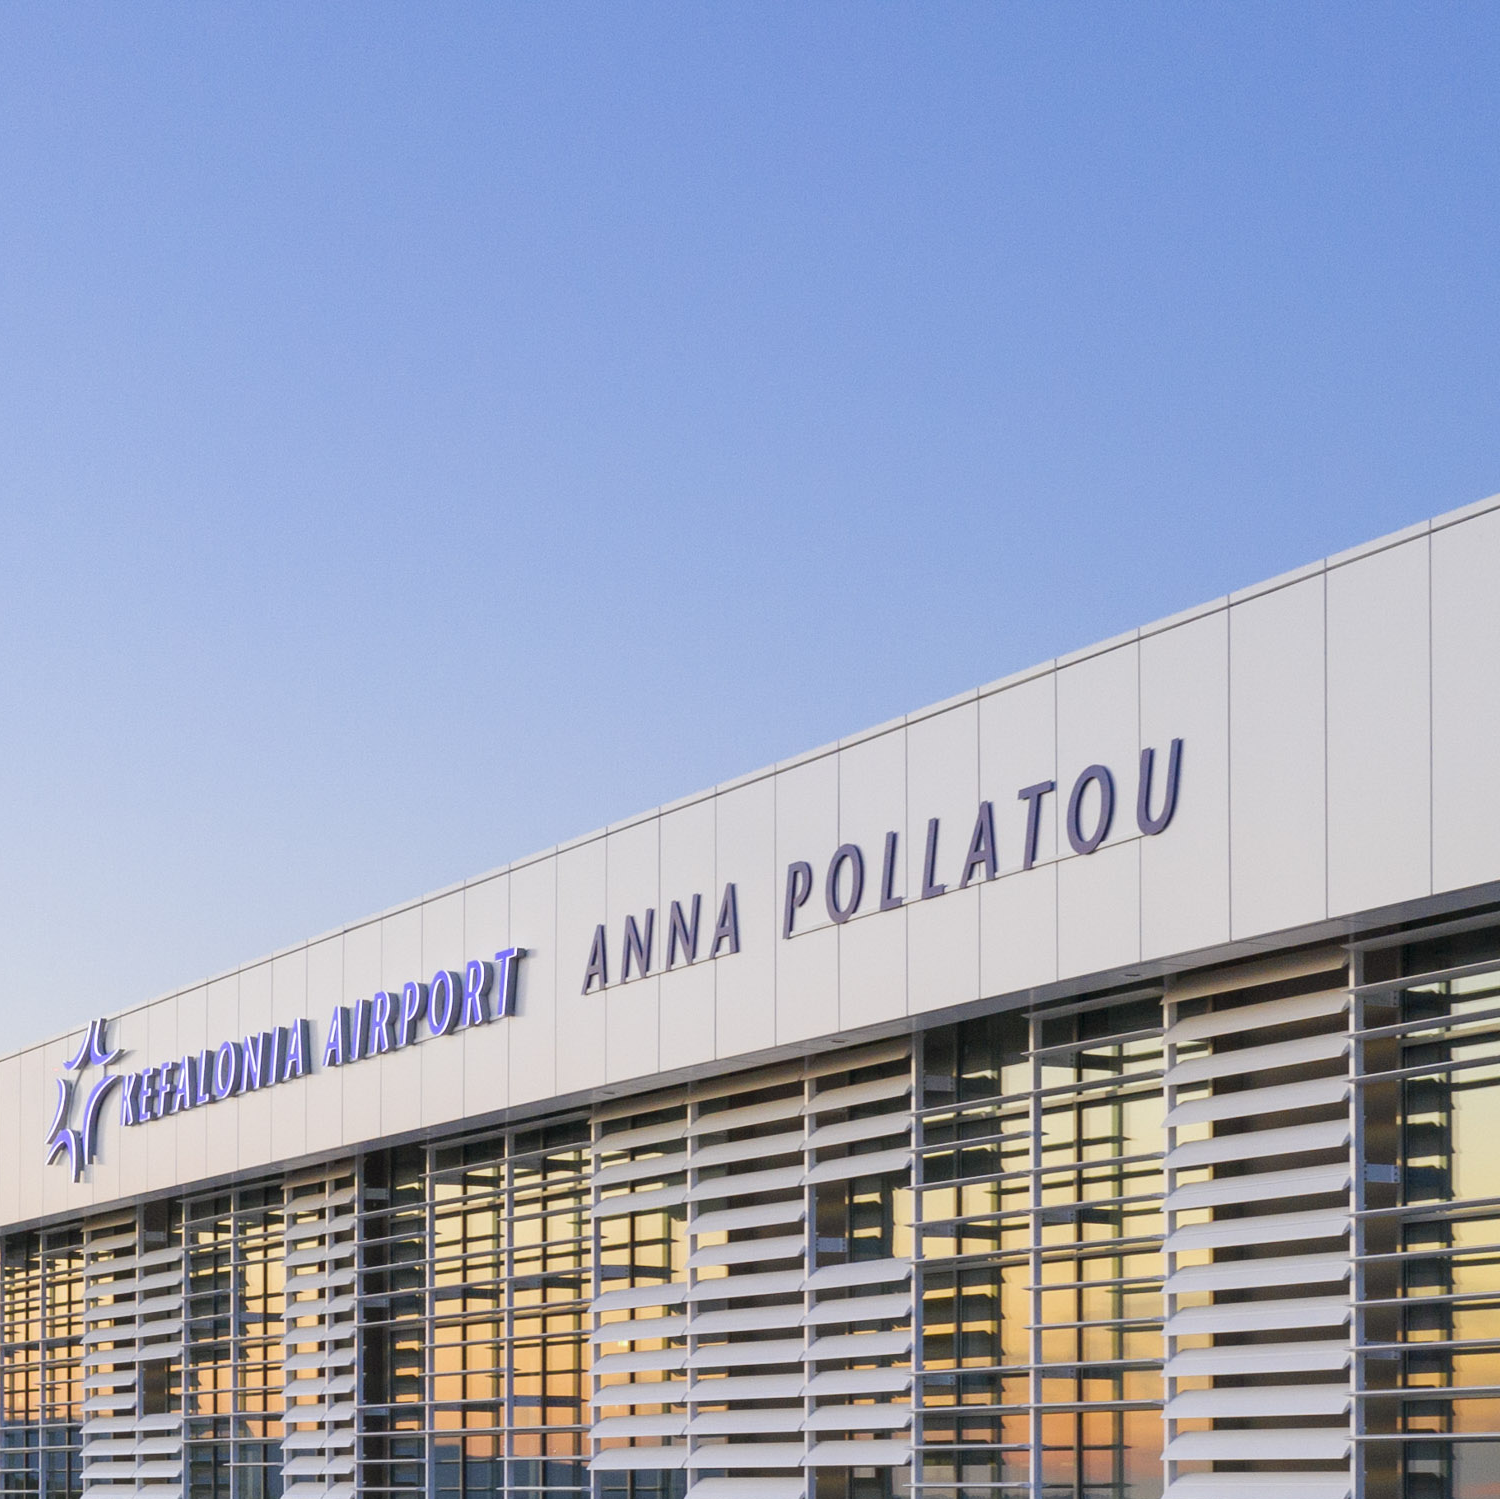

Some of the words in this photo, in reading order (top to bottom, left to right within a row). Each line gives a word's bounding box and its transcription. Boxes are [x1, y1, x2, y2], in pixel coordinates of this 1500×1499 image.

[581, 882, 740, 996] ANNA
[782, 738, 1184, 939] POLLATOU
[120, 1017, 311, 1126] KEFALONIA
[322, 947, 527, 1067] AIRPORT
